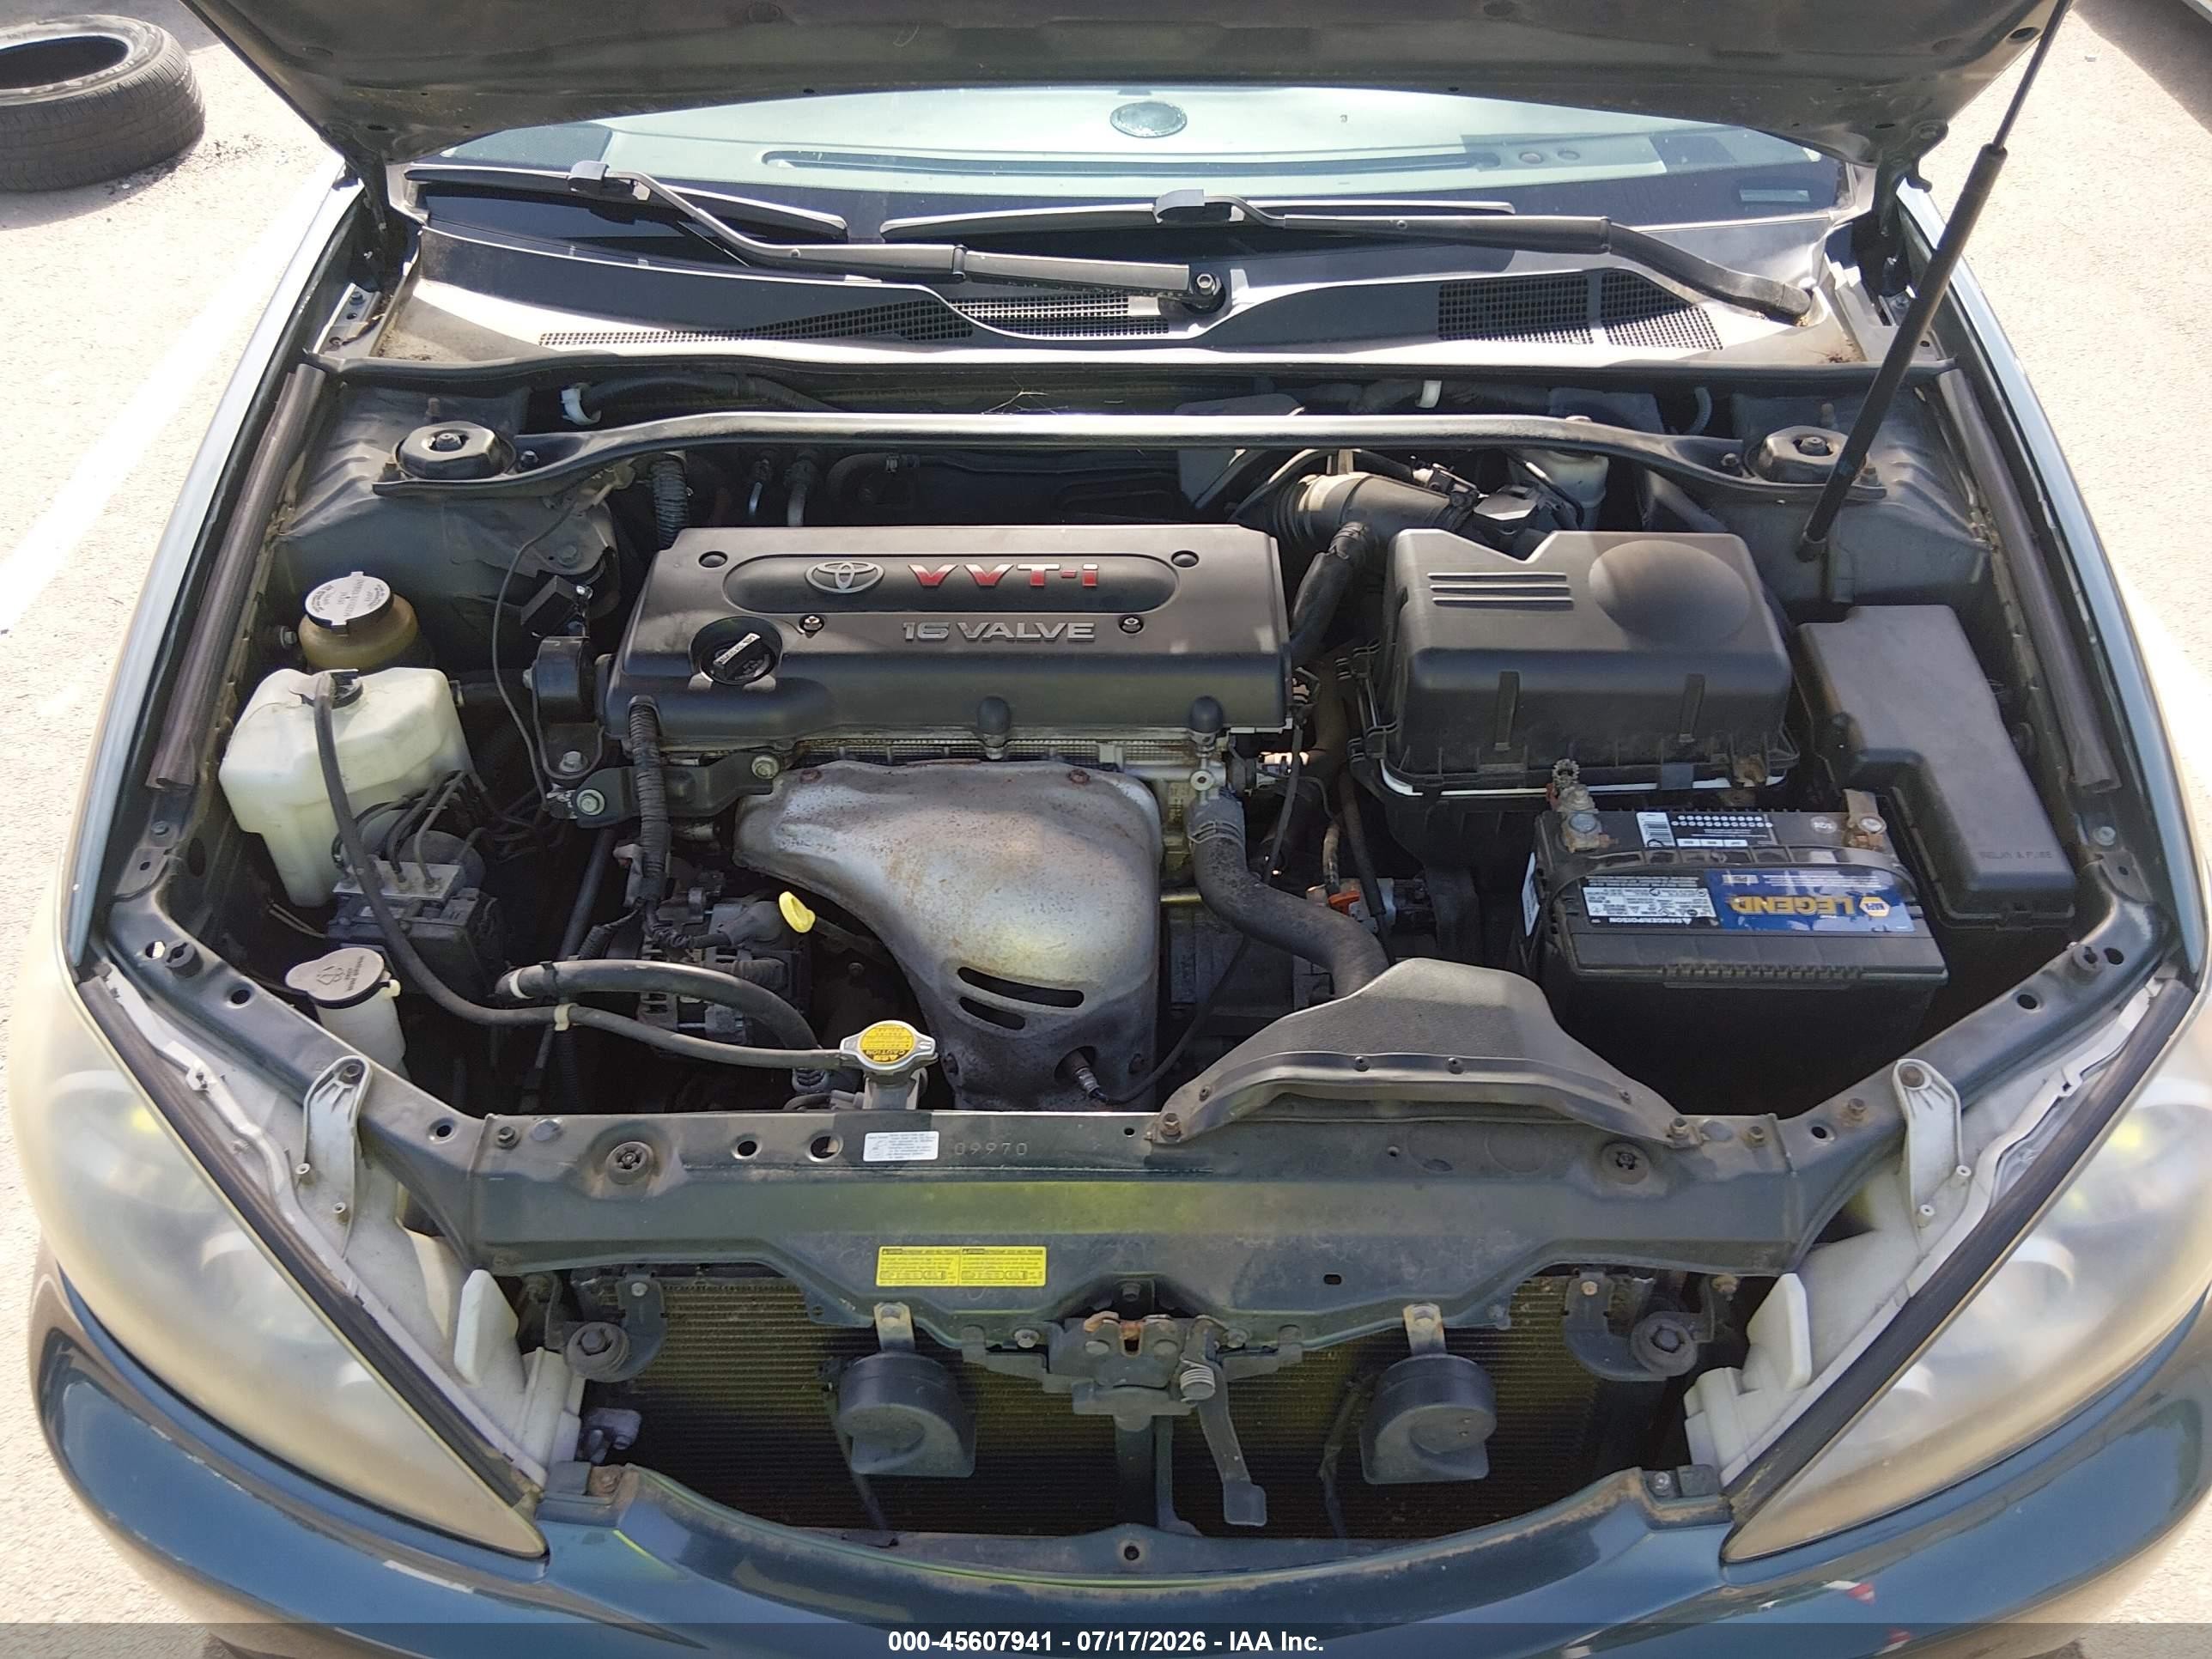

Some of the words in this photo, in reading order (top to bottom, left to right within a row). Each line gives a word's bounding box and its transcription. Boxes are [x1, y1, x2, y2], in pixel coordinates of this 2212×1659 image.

[908, 563, 1099, 586] VVT-i
[902, 621, 951, 641] 16
[956, 621, 1096, 642] VALVE
[1729, 896, 1856, 915] LEGEND
[954, 1142, 1028, 1156] 09970
